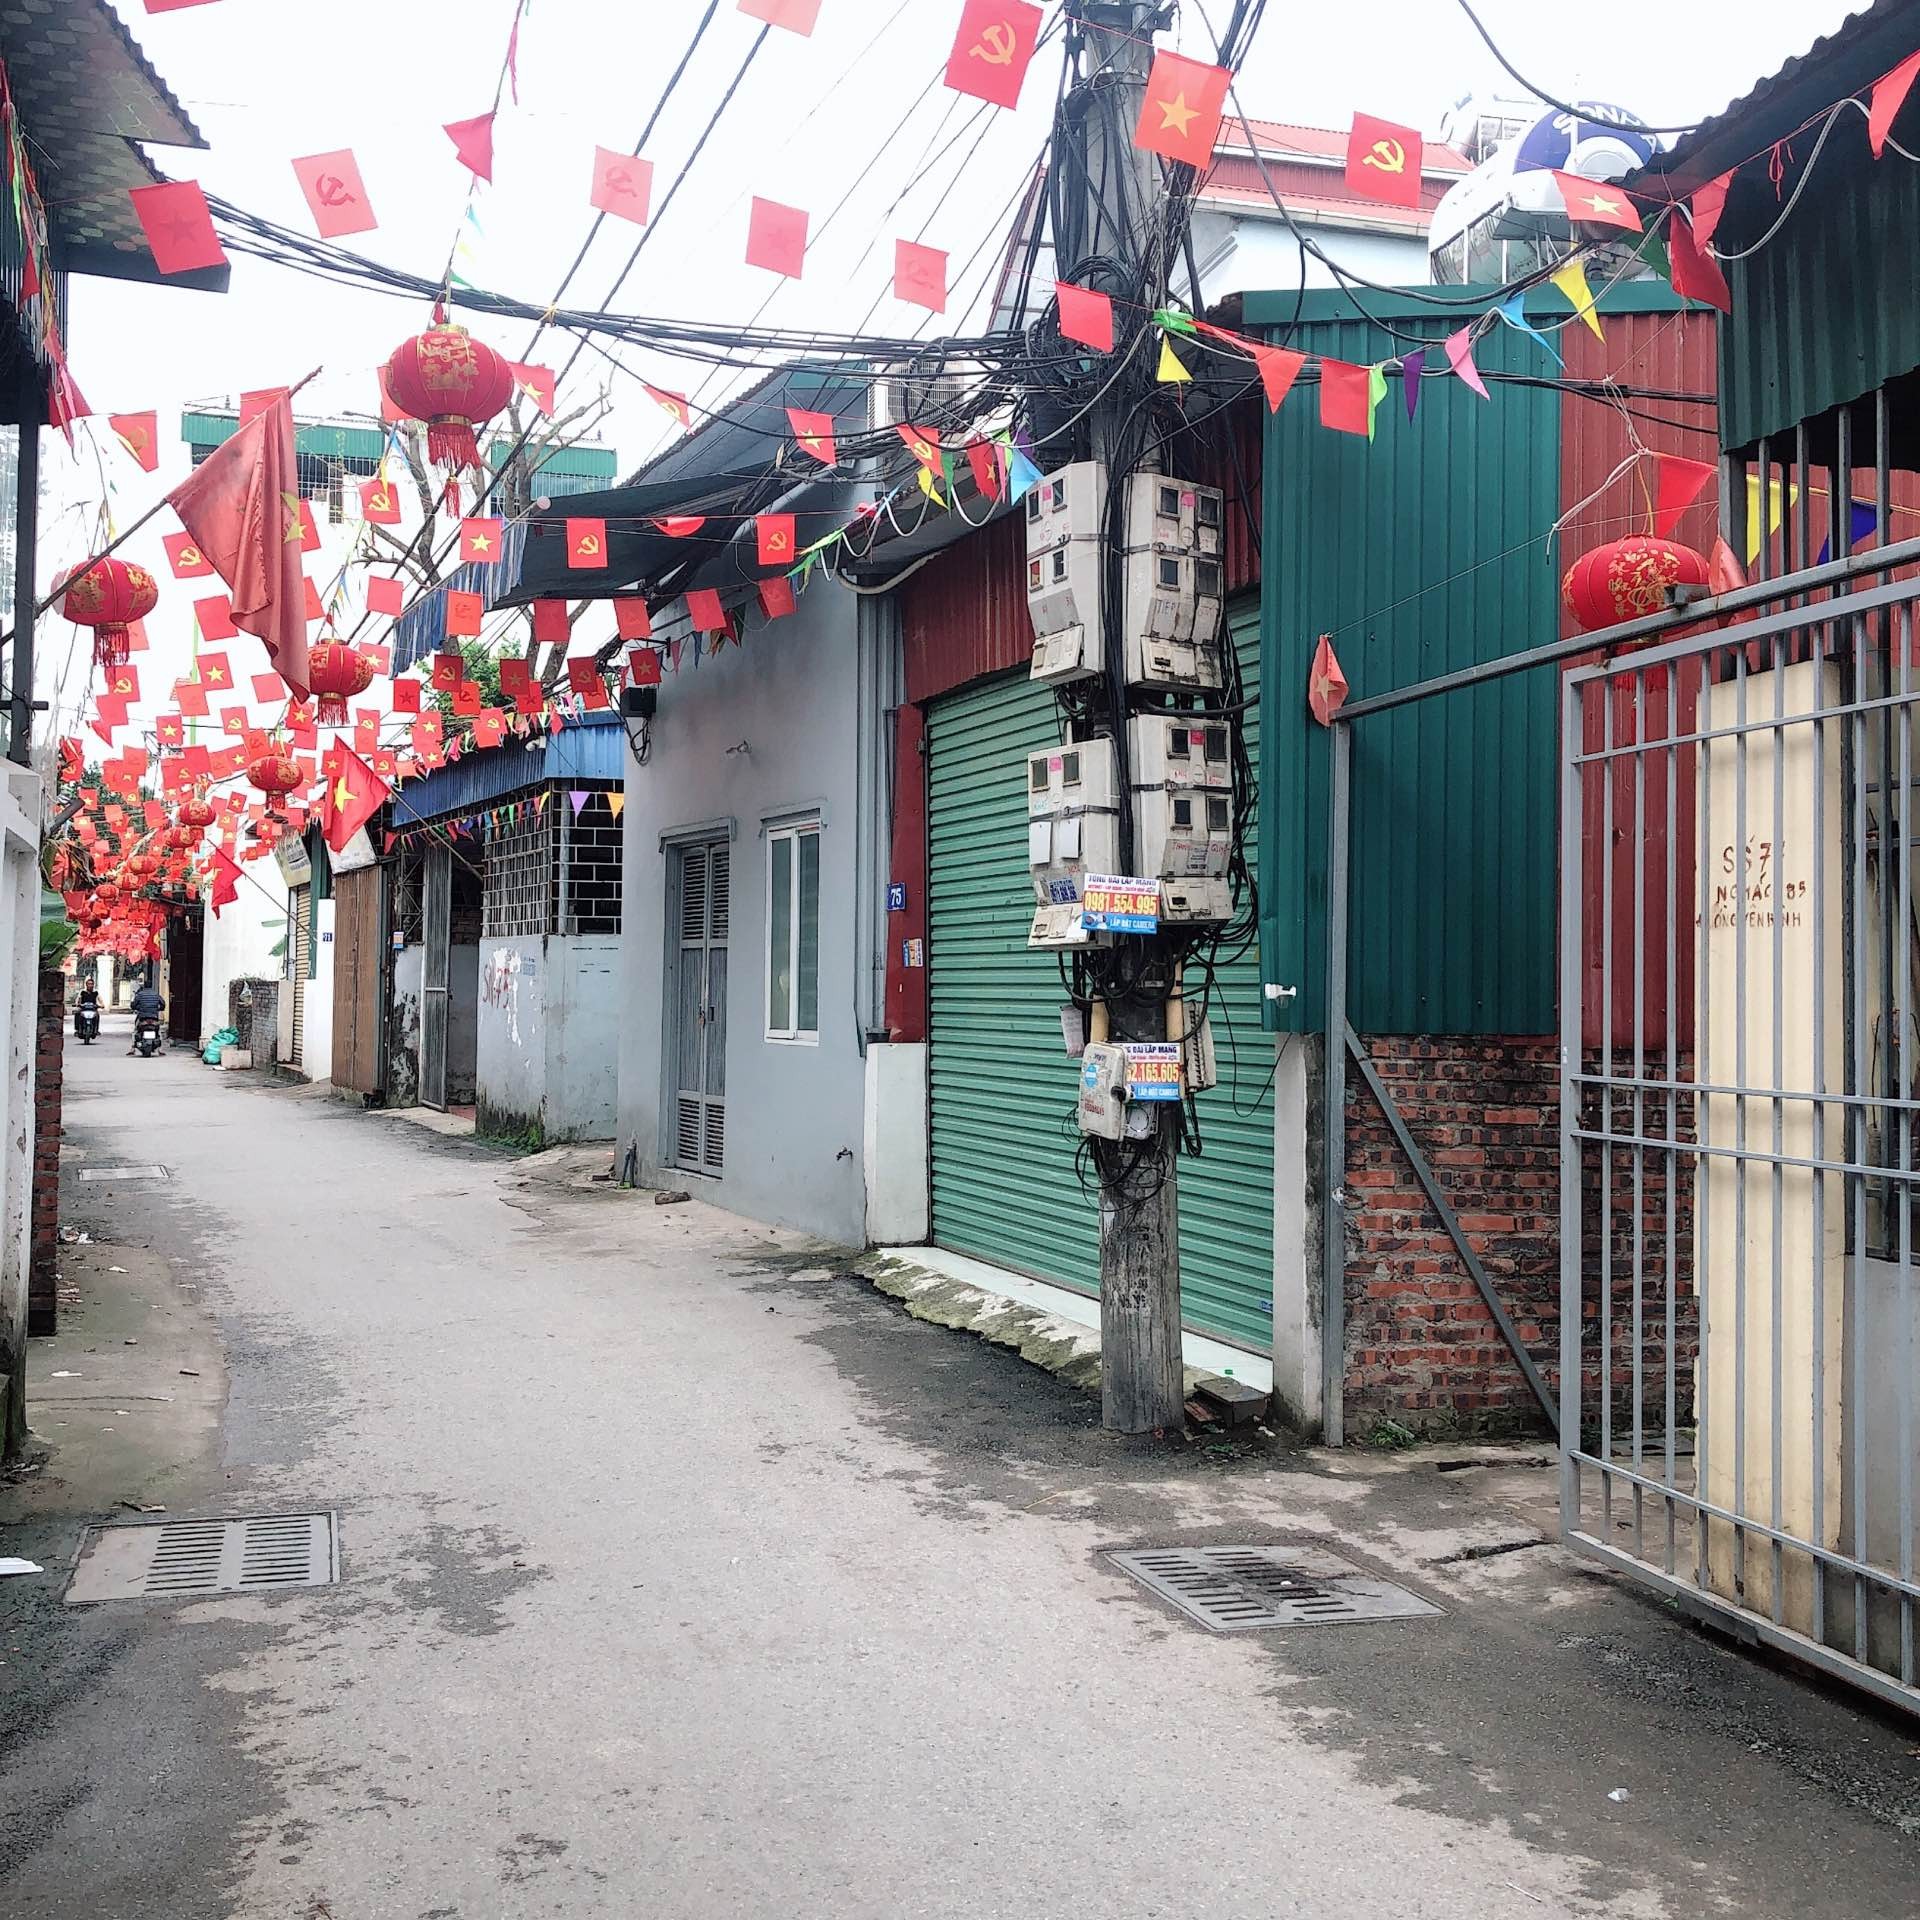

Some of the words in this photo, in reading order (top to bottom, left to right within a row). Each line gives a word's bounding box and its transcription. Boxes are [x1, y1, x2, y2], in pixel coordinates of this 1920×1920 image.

[891, 887, 902, 906] 75
[1786, 880, 1806, 900] 85
[1085, 892, 1157, 915] 0981.554.995
